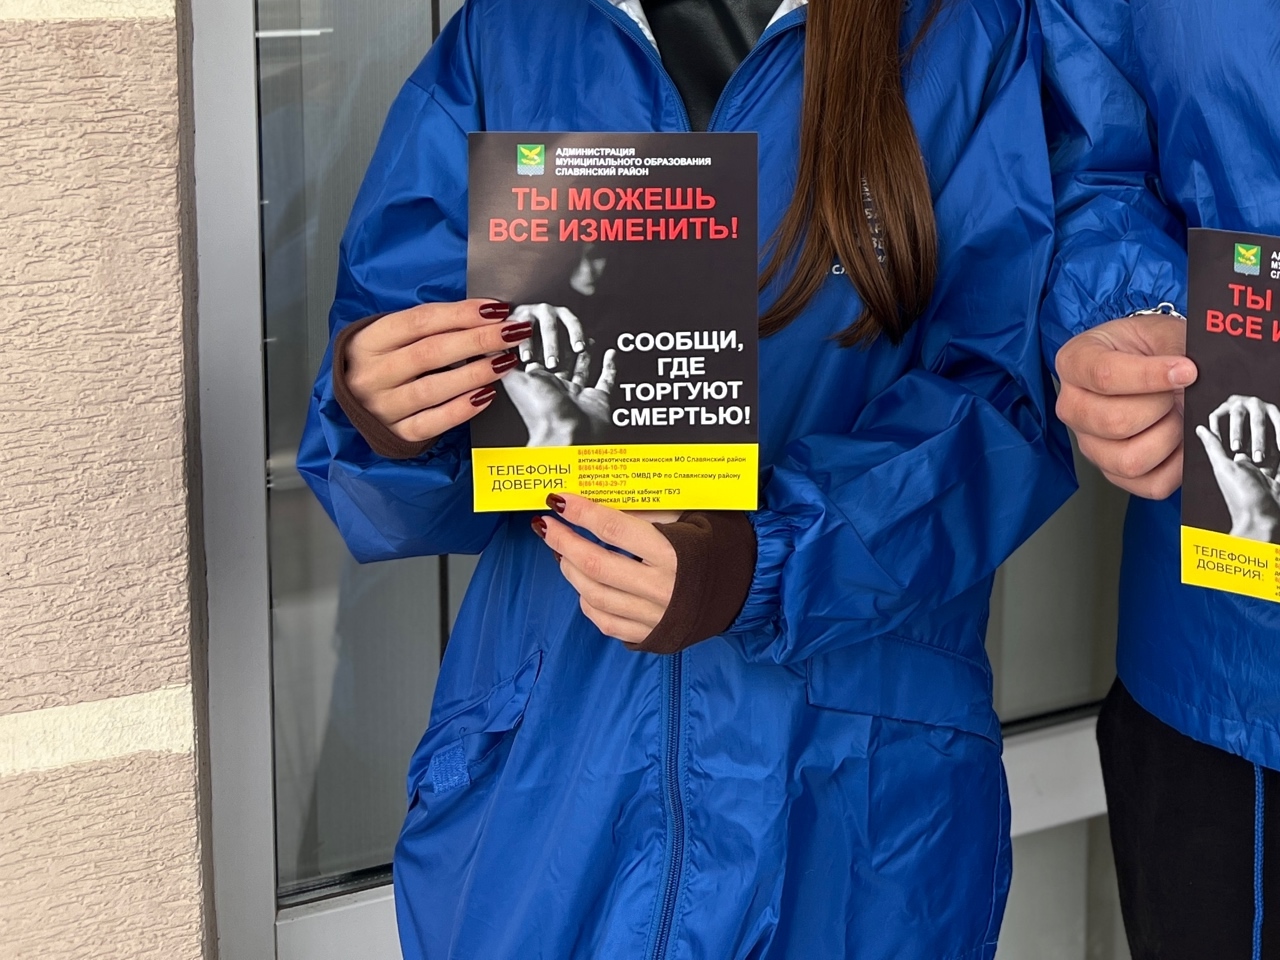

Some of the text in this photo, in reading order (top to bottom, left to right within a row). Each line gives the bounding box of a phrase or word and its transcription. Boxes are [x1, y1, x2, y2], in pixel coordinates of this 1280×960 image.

[555, 147, 635, 157] АДМИНИСТРАЦИЯ
[555, 156, 711, 167] МУНИЦИПАЛЬНОГО ОБРАЗОВАНИЯ
[554, 166, 649, 176] СЛАВЯНСКИЙ РАЙОН
[511, 187, 716, 210] ТЫ МОЖЕШЬ
[488, 216, 737, 242] ВСЕ ИЗМЕНИТЬ!
[1227, 283, 1272, 311] ТЫ
[1206, 309, 1263, 339] ВСЕ
[616, 329, 743, 352] СООБЩИ,
[657, 356, 705, 379] ГДЕ
[619, 380, 743, 401] ТОРГУЮТ
[611, 405, 750, 426] СМЕРТЬЮ!
[486, 463, 571, 476] ТЕЛЕФОНЫ
[490, 477, 567, 492] ДОВЕРИЯ:
[1193, 544, 1268, 569] ТЕЛЕФОНЫ
[1195, 557, 1265, 581] ДОВЕРИЯ:
